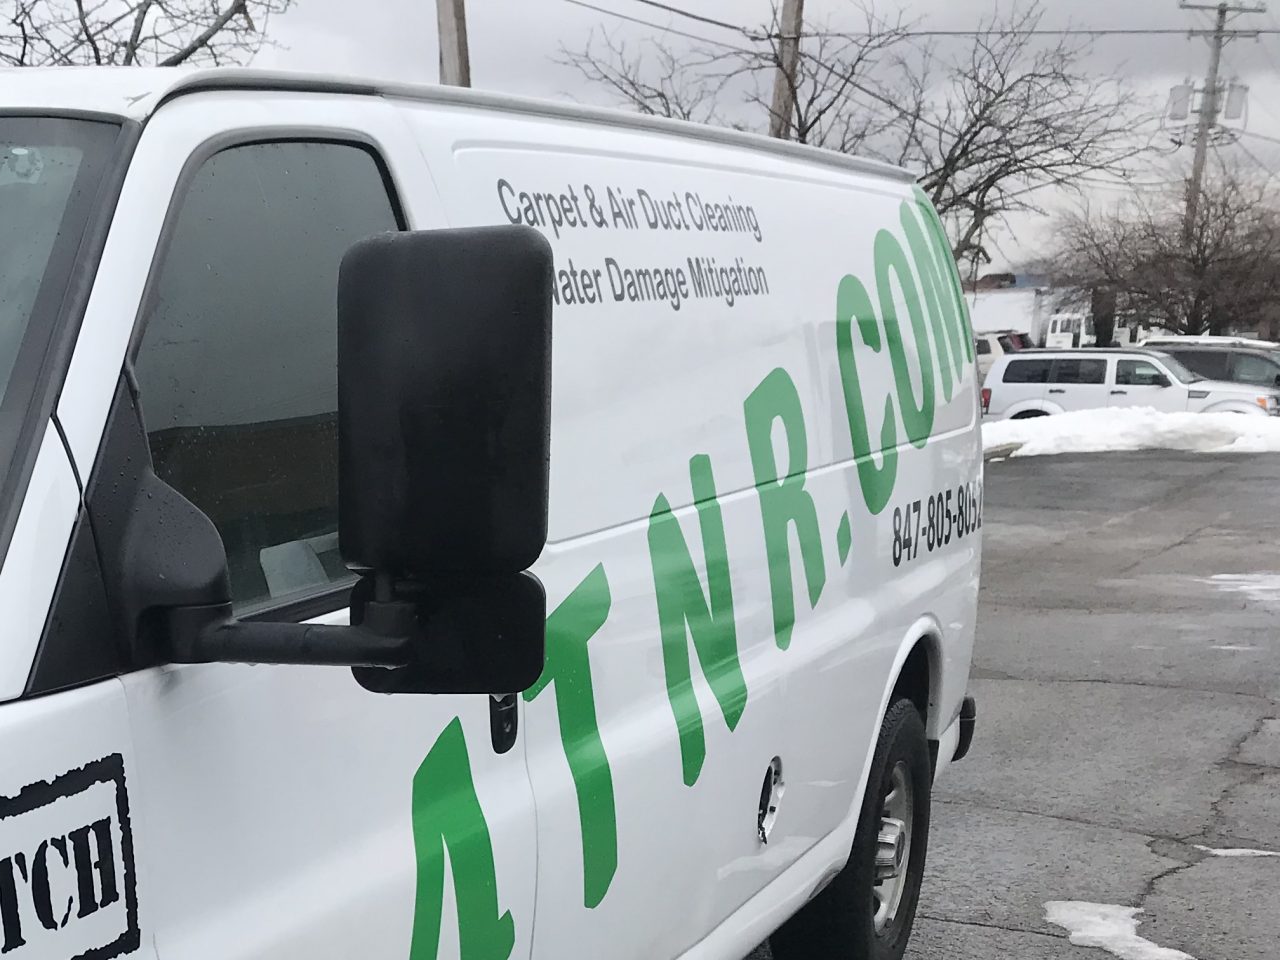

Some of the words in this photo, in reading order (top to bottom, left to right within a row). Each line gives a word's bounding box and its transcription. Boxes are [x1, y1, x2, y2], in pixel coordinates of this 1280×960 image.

[497, 178, 588, 239] Carpet
[584, 184, 609, 229] &
[607, 185, 639, 230] Air
[637, 188, 690, 231] Duct
[685, 191, 762, 243] Cleaning
[604, 257, 689, 311] Damage
[687, 256, 769, 307] Mitigation
